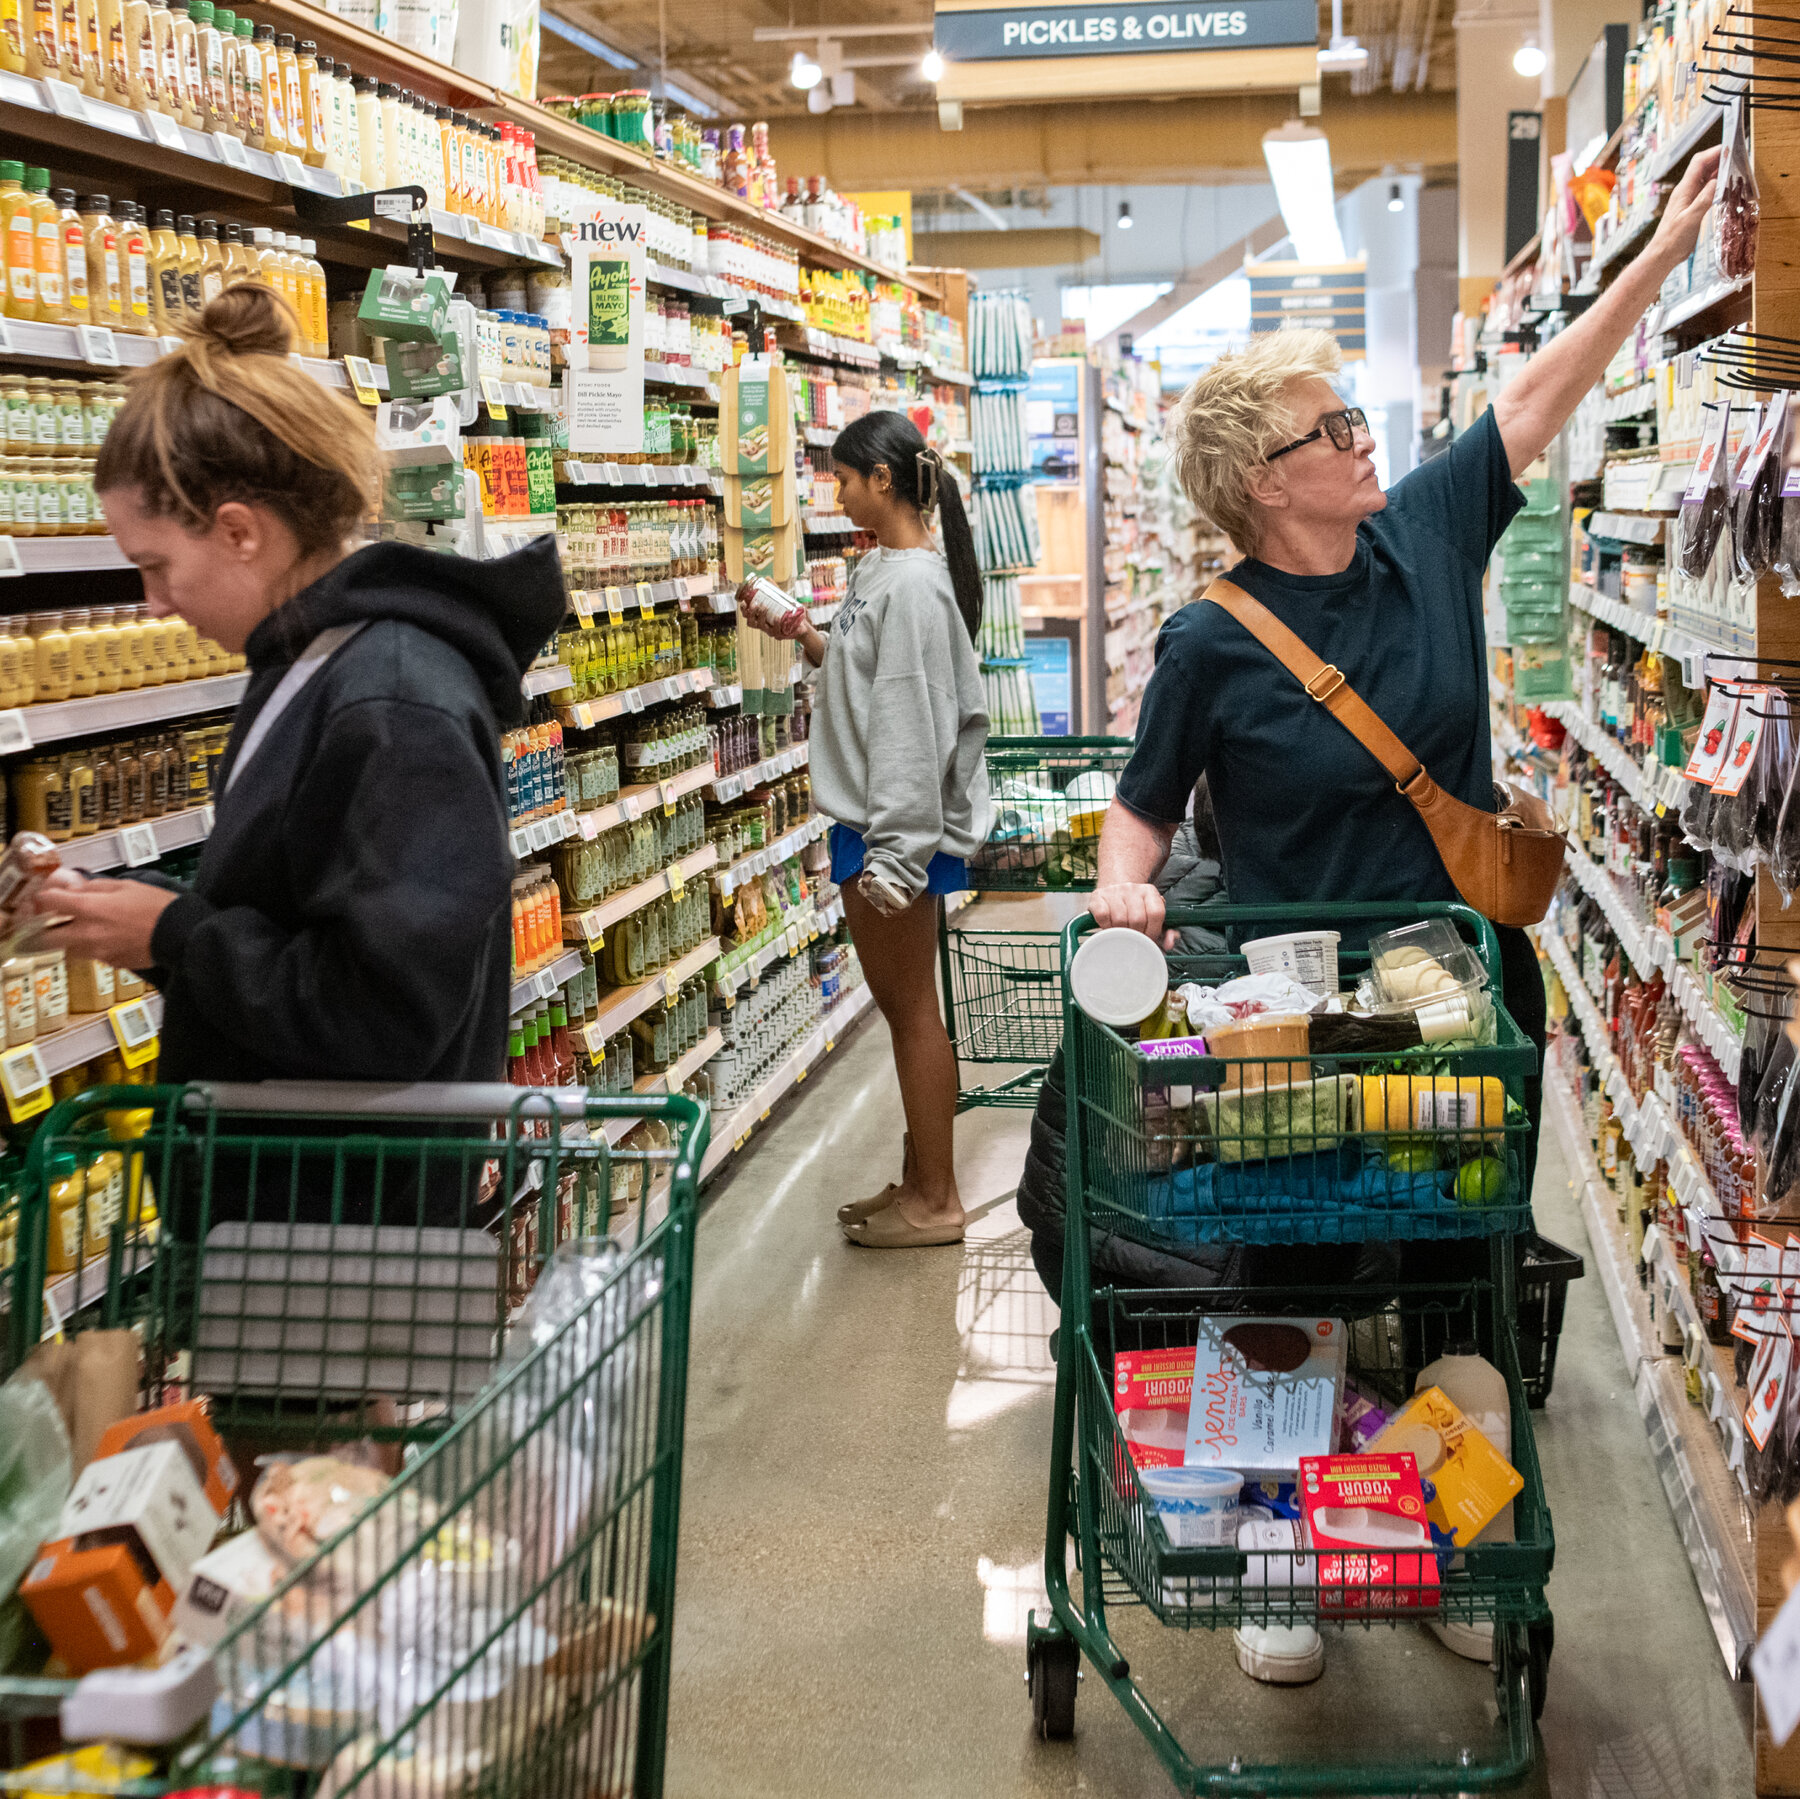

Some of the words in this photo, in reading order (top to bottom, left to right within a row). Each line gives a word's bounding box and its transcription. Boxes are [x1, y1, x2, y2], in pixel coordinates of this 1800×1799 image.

[1003, 16, 1118, 46] PICKLES
[1122, 16, 1143, 40] &
[1147, 11, 1248, 39] OLIVES
[579, 222, 641, 241] new
[1153, 1361, 1175, 1371] DESSERT
[1144, 1379, 1194, 1397] YOGURT
[1148, 1394, 1190, 1406] STRAWBERRY
[1195, 1356, 1237, 1460] jeni's
[1229, 1384, 1239, 1415] CREAM
[1239, 1396, 1247, 1418] BARS
[1228, 1417, 1236, 1431] ICE
[1252, 1399, 1263, 1431] Vanilla
[1263, 1413, 1275, 1454] Caramel
[1343, 1464, 1367, 1473] DESSERT
[1368, 1463, 1391, 1472] FROZEN
[1338, 1480, 1392, 1496] YOGURT
[1344, 1495, 1389, 1505] STRAWBERRY
